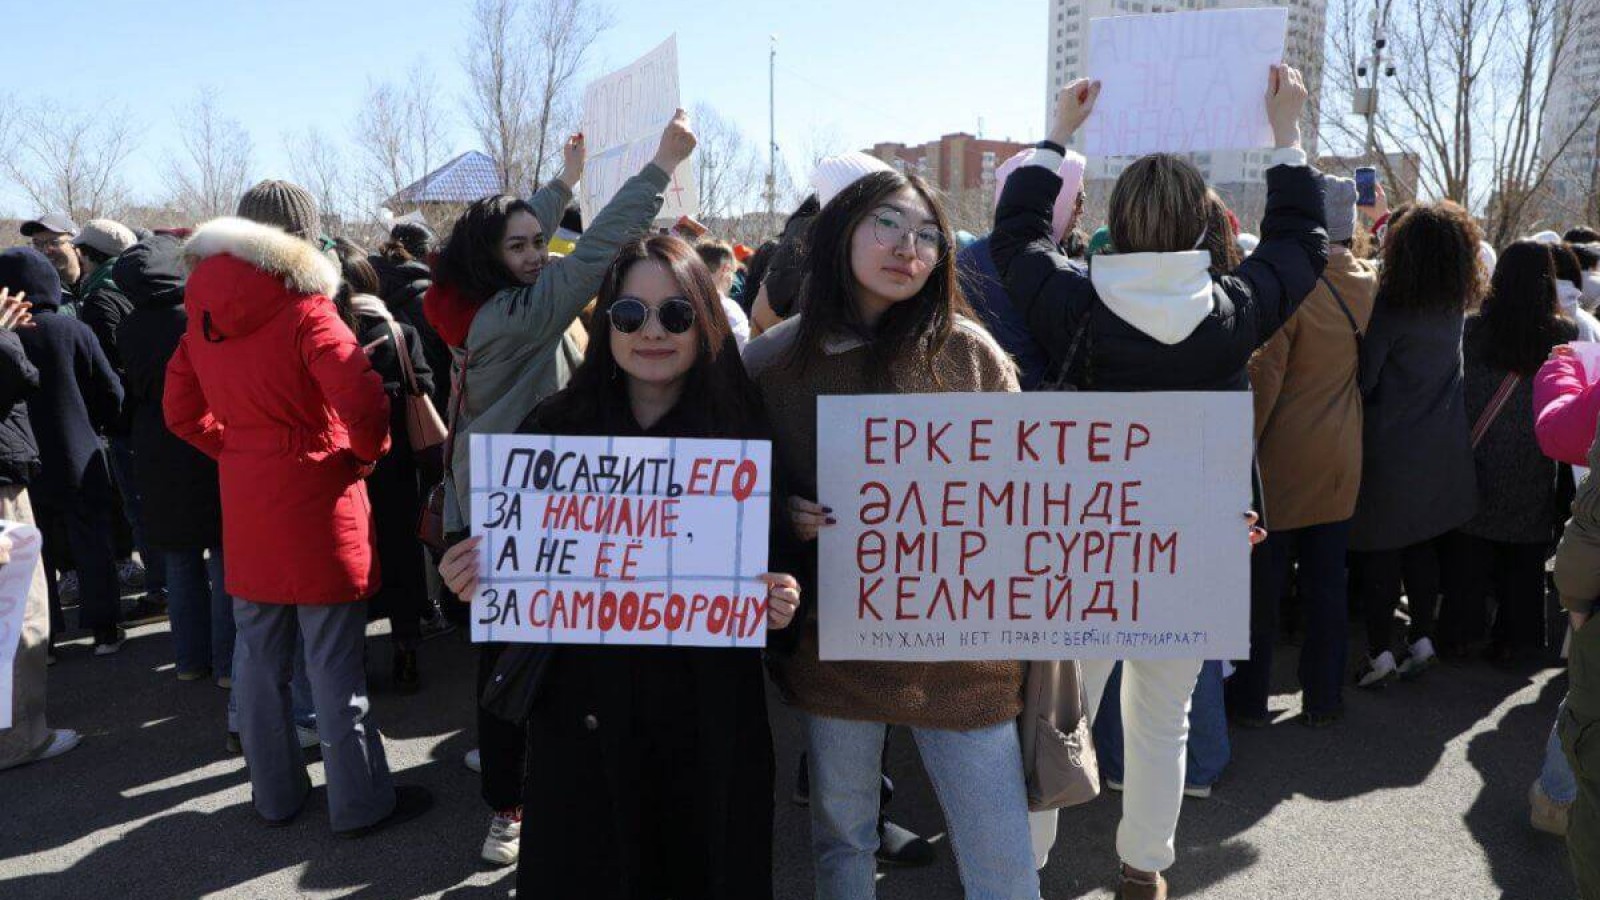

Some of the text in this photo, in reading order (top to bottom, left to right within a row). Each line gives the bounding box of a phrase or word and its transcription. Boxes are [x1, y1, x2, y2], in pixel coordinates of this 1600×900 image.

[865, 417, 1151, 464] ЕРКЕКТЕР
[502, 448, 758, 502] ПОСАДИТЬ ЕГО
[483, 492, 693, 543] ЗА НАСИЛИЕ,
[859, 480, 1142, 527] ӘЛЕМІНДЕ
[496, 536, 643, 581] А НЕ ЕЁ
[857, 530, 987, 575] ӨМІР
[478, 589, 768, 638] ЗА САМООБОРОНУ
[858, 574, 1138, 622] КЕЛМЕЙДІ
[960, 631, 990, 646] НЕТ
